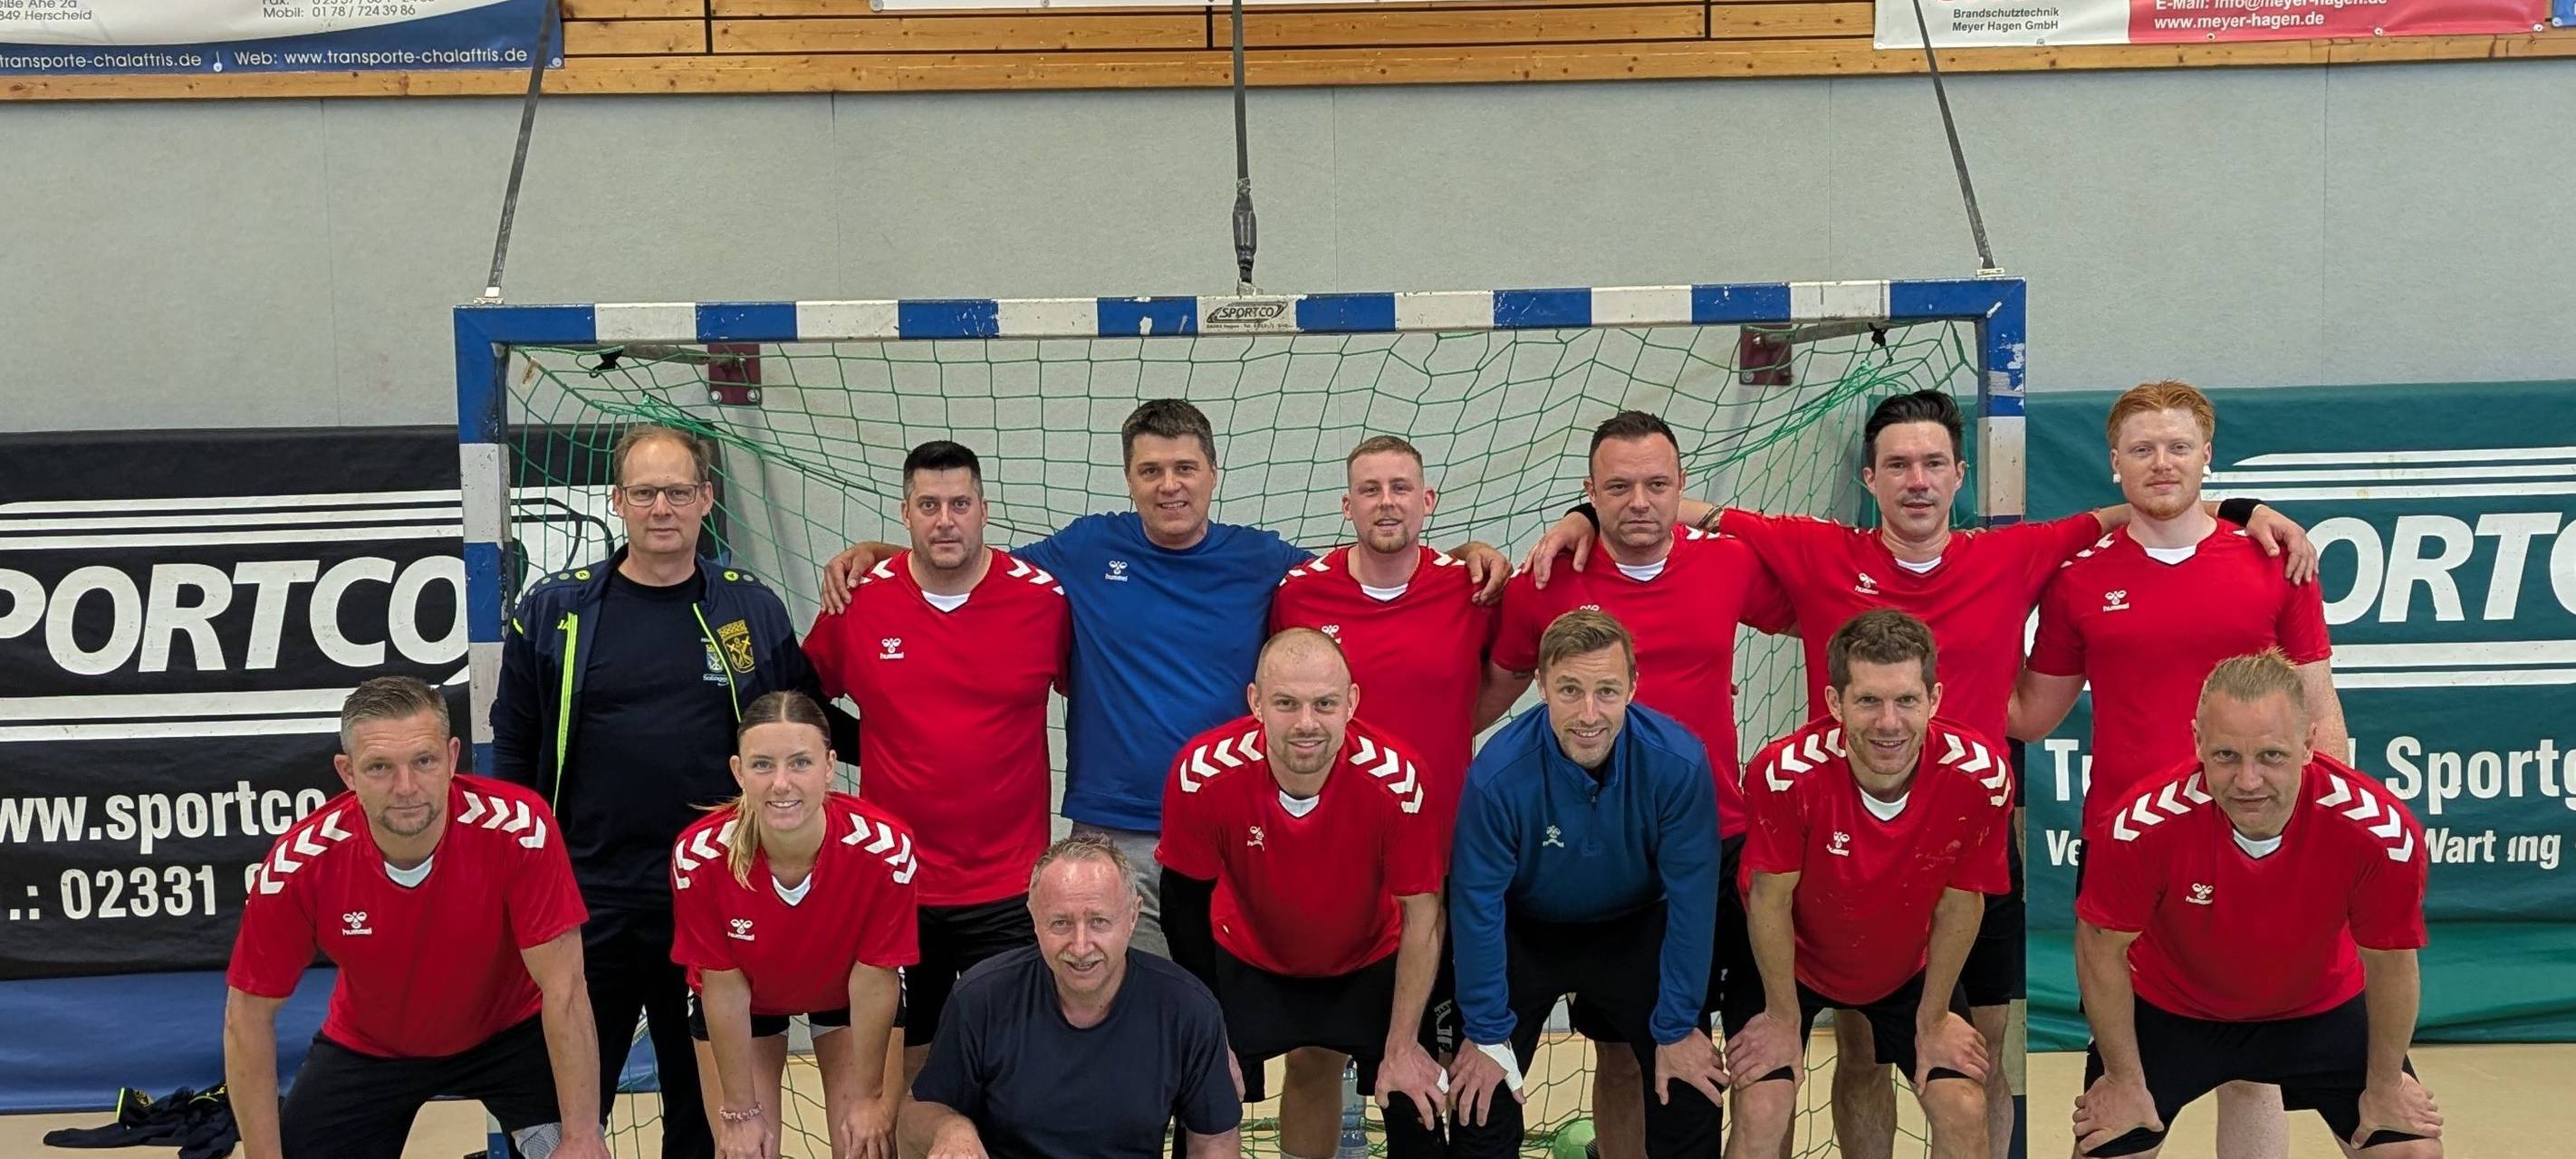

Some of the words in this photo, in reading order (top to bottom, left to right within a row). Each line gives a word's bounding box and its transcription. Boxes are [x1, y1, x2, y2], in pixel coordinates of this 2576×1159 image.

[25, 10, 92, 20] Herscheid
[264, 7, 304, 18] Mobil:
[1954, 7, 2060, 18] Brandschutztechnik
[1952, 22, 1985, 34] Meyer
[1987, 21, 2022, 33] Hagen
[2025, 20, 2059, 30] GmbH
[2154, 12, 2324, 30] www.meyer-hagen.de
[235, 51, 278, 65] Web:
[284, 48, 528, 66] www.transporte-chalaftris.de
[1219, 307, 1274, 319] SPORTCO
[60, 865, 216, 920] 02331
